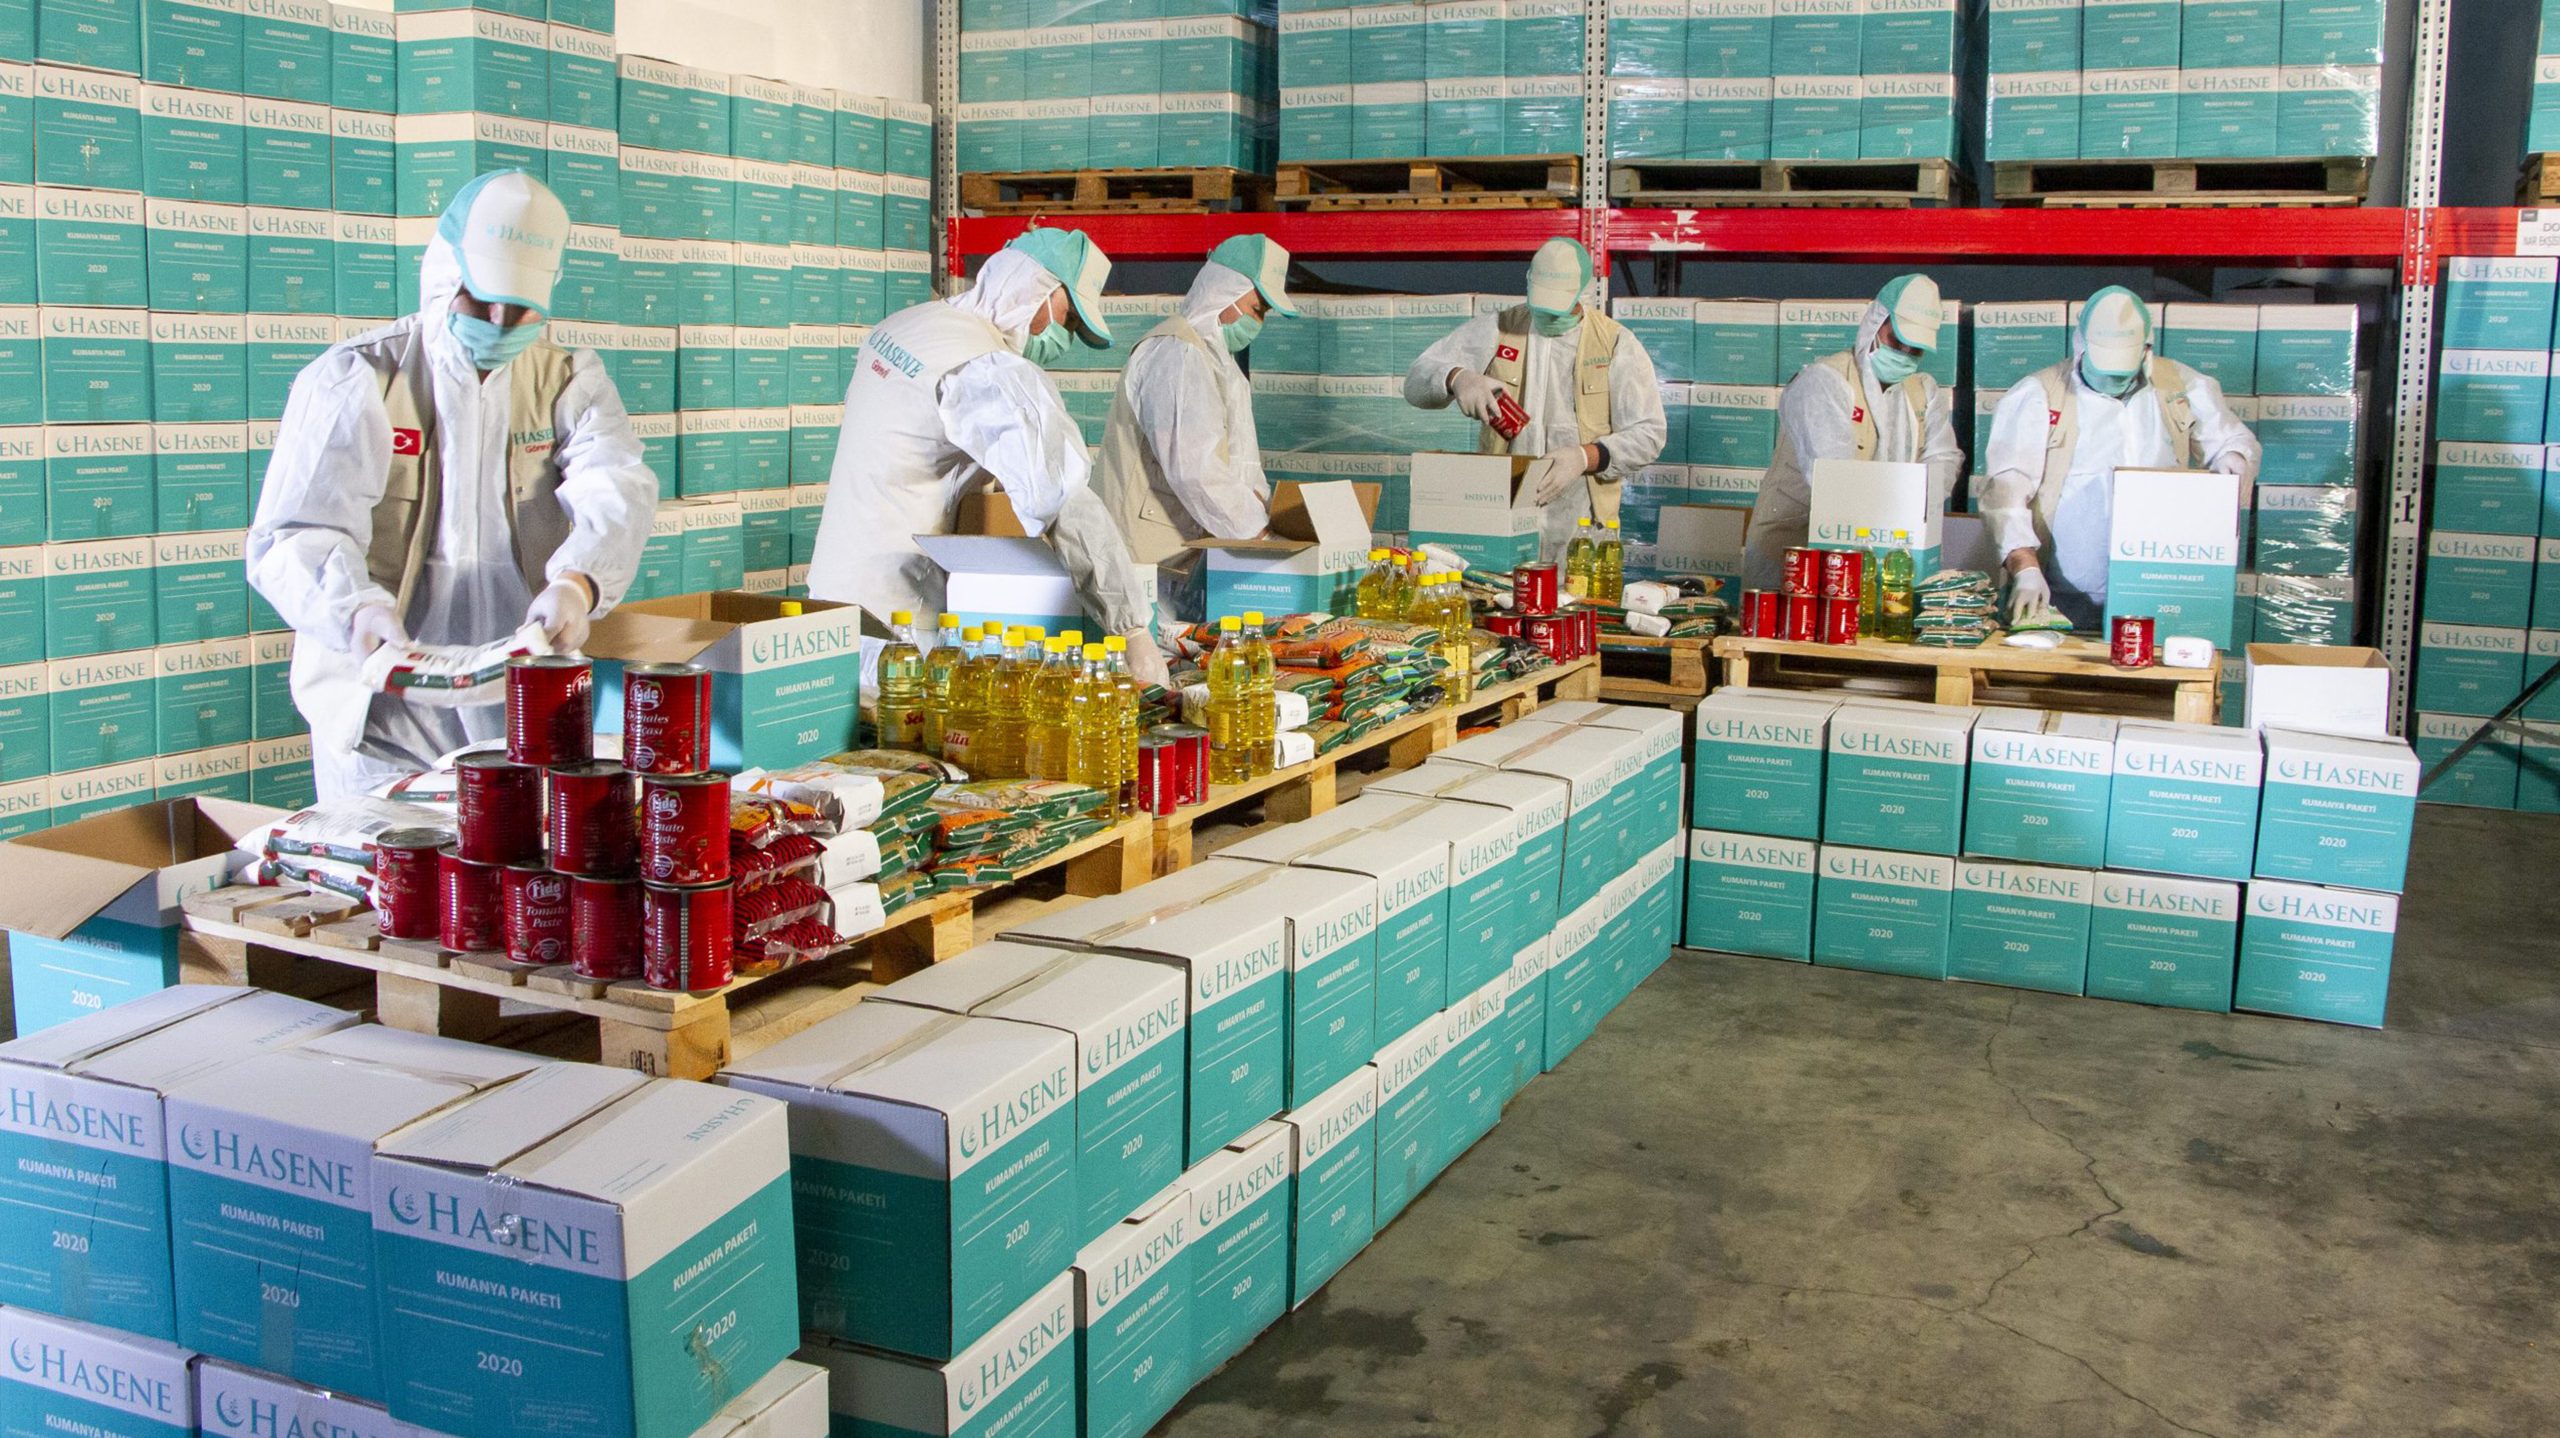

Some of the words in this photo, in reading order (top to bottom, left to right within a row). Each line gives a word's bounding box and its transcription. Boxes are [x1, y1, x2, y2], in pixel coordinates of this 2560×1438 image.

[490, 20, 543, 46] HASENE
[566, 35, 613, 58] HASENE
[60, 76, 133, 105] HASENE
[1882, 81, 1945, 96] HASENE
[2010, 79, 2073, 95] HASENE
[2105, 77, 2170, 93] HASENE
[168, 96, 235, 121] HASENE
[264, 108, 324, 130] HASENE
[690, 158, 730, 177] HASENE
[64, 199, 136, 221] HASENE
[267, 216, 328, 236] HASENE
[2474, 263, 2548, 280] HASENE
[1631, 304, 1689, 319] HASENE
[1800, 309, 1859, 323] HASENE
[1995, 310, 2057, 325] HASENE
[70, 315, 141, 335] HASENE
[874, 331, 925, 379] HASENE
[1711, 392, 1768, 407] HASENE
[695, 417, 732, 431] HASENE
[74, 435, 144, 452] HASENE
[175, 433, 241, 451] HASENE
[513, 428, 554, 446] HASE
[2463, 449, 2534, 467] HASENE
[696, 511, 737, 528] HASENE
[72, 550, 144, 571] HASENE
[175, 542, 240, 561] HASENE
[1332, 551, 1368, 569] HASENE
[2139, 540, 2226, 561] HASENE
[2453, 540, 2525, 560] HASENE
[1676, 554, 1733, 571] HASENE
[2157, 604, 2182, 614] 2020
[772, 625, 851, 662] HASENE
[2445, 631, 2516, 651] HASENE
[180, 650, 242, 670] HASENE
[77, 661, 146, 685] HASENE
[775, 681, 810, 697] KUMANYA
[811, 674, 835, 689] PAKETİ
[797, 728, 819, 745] 2020
[1652, 727, 1681, 752] HASENE
[1726, 719, 1814, 746] HASENE
[1861, 732, 1953, 760] HASENE
[2005, 740, 2101, 769] HASENE
[1614, 751, 1643, 780] HASENE
[1727, 753, 1764, 766] KUMANYA
[2148, 752, 2247, 782] HASENE
[1862, 767, 1900, 780] KUMANYA
[2005, 777, 2043, 790] KUMANYA
[2301, 760, 2404, 791] HASENE
[77, 772, 147, 799] HASENE
[1581, 771, 1612, 801] HASENE
[1745, 788, 1769, 800] 2020
[2148, 789, 2189, 802] KUMANYA
[1879, 803, 1905, 815] 2020
[2301, 797, 2344, 811] KUMANYA
[1526, 801, 1564, 837] HASENE
[2022, 813, 2049, 826] 2020
[2171, 826, 2198, 840] 2020
[2318, 835, 2347, 849] 2020
[1470, 830, 1515, 872] HASENE
[1720, 840, 1808, 868] HASENE
[1721, 875, 1757, 887] KUMANYA
[1850, 857, 1941, 886] HASENE
[1986, 868, 2080, 898] HASENE
[1395, 862, 1446, 908] HASENE
[1609, 881, 1639, 915] HASENE
[1851, 891, 1889, 904] KUMANYA
[2126, 886, 2223, 916] HASENE
[525, 905, 568, 917] Tomato
[1737, 909, 1762, 921] 2020
[1986, 904, 2026, 917] KUMANYA
[2280, 895, 2383, 927] HASENE
[532, 917, 563, 929] Paste
[1315, 903, 1373, 955] HASENE
[1564, 917, 1599, 952] HASENE
[1868, 927, 1893, 939] 2020
[2127, 922, 2167, 935] KUMANYA
[2004, 940, 2030, 952] 2020
[2280, 932, 2323, 946] KUMANYA
[1216, 939, 1280, 992] HASENE
[1406, 967, 1420, 984] 2020
[1507, 950, 1545, 991] HASENE
[2149, 959, 2177, 972] 2020
[2298, 969, 2326, 983] 2020
[71, 989, 102, 1010] 2020
[1458, 990, 1501, 1038] HASENE
[1105, 997, 1180, 1067] HASENE
[1328, 1015, 1345, 1037] 2020
[1394, 1034, 1440, 1088] HASENE
[1230, 1062, 1249, 1084] 2020
[1106, 1077, 1142, 1108] KUMANYA
[1142, 1062, 1163, 1090] PAKETİ
[11, 1087, 145, 1147] HASENE
[981, 1066, 1069, 1148] HASENE
[1319, 1090, 1373, 1150] HASENE
[1121, 1133, 1144, 1159] 2020
[18, 1158, 76, 1182] KUMANYA
[77, 1169, 117, 1190] PAKETİ
[213, 1128, 355, 1199] HASENE
[985, 1161, 1024, 1195] KUMANYA
[1024, 1140, 1050, 1169] PAKETİ
[1217, 1150, 1285, 1219] HASENE
[220, 1203, 280, 1231] KUMANYA
[282, 1217, 325, 1242] PAKETİ
[1330, 1204, 1347, 1227] 2020
[428, 1191, 600, 1265] HASENE
[1005, 1219, 1030, 1250] 2020
[1218, 1226, 1248, 1256] KUMANYA
[1248, 1209, 1270, 1234] PAKETİ
[52, 1230, 89, 1254] 2020
[673, 1246, 723, 1292] KUMANYA
[725, 1218, 758, 1263] PAKETİ
[1113, 1217, 1185, 1297] HASENE
[261, 1282, 299, 1309] 2020
[436, 1270, 508, 1298] KUMANYA
[511, 1286, 562, 1310] PAKETİ
[1232, 1275, 1252, 1300] 2020
[1116, 1300, 1148, 1336] KUMANYA
[1148, 1283, 1170, 1313] PAKETİ
[706, 1310, 737, 1346] 2020
[981, 1303, 1068, 1400] HASENE
[477, 1351, 523, 1377] 2020
[1133, 1355, 1154, 1384] 2020
[41, 1342, 172, 1415] HASENE
[1027, 1375, 1050, 1407] PAKETİ
